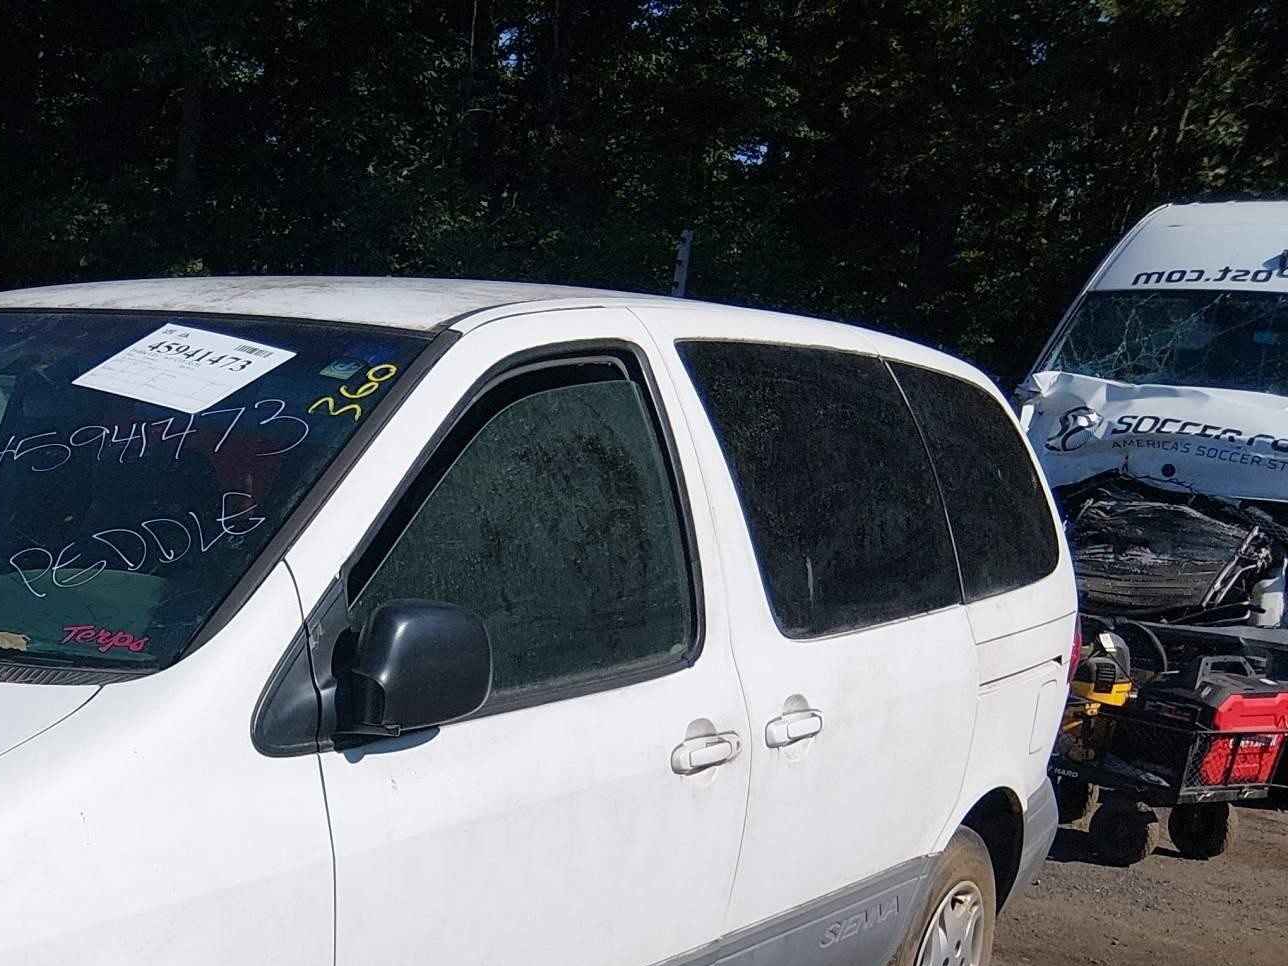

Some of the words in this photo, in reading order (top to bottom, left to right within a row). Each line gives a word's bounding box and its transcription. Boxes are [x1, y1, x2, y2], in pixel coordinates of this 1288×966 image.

[148, 340, 253, 372] 45941473
[308, 363, 397, 421] 360
[1112, 439, 1192, 454] AMERICA'S
[1195, 445, 1262, 467] SOCCER
[10, 492, 266, 598] PEDDLE
[59, 625, 150, 653] Terps
[819, 895, 900, 949] SIENNA
